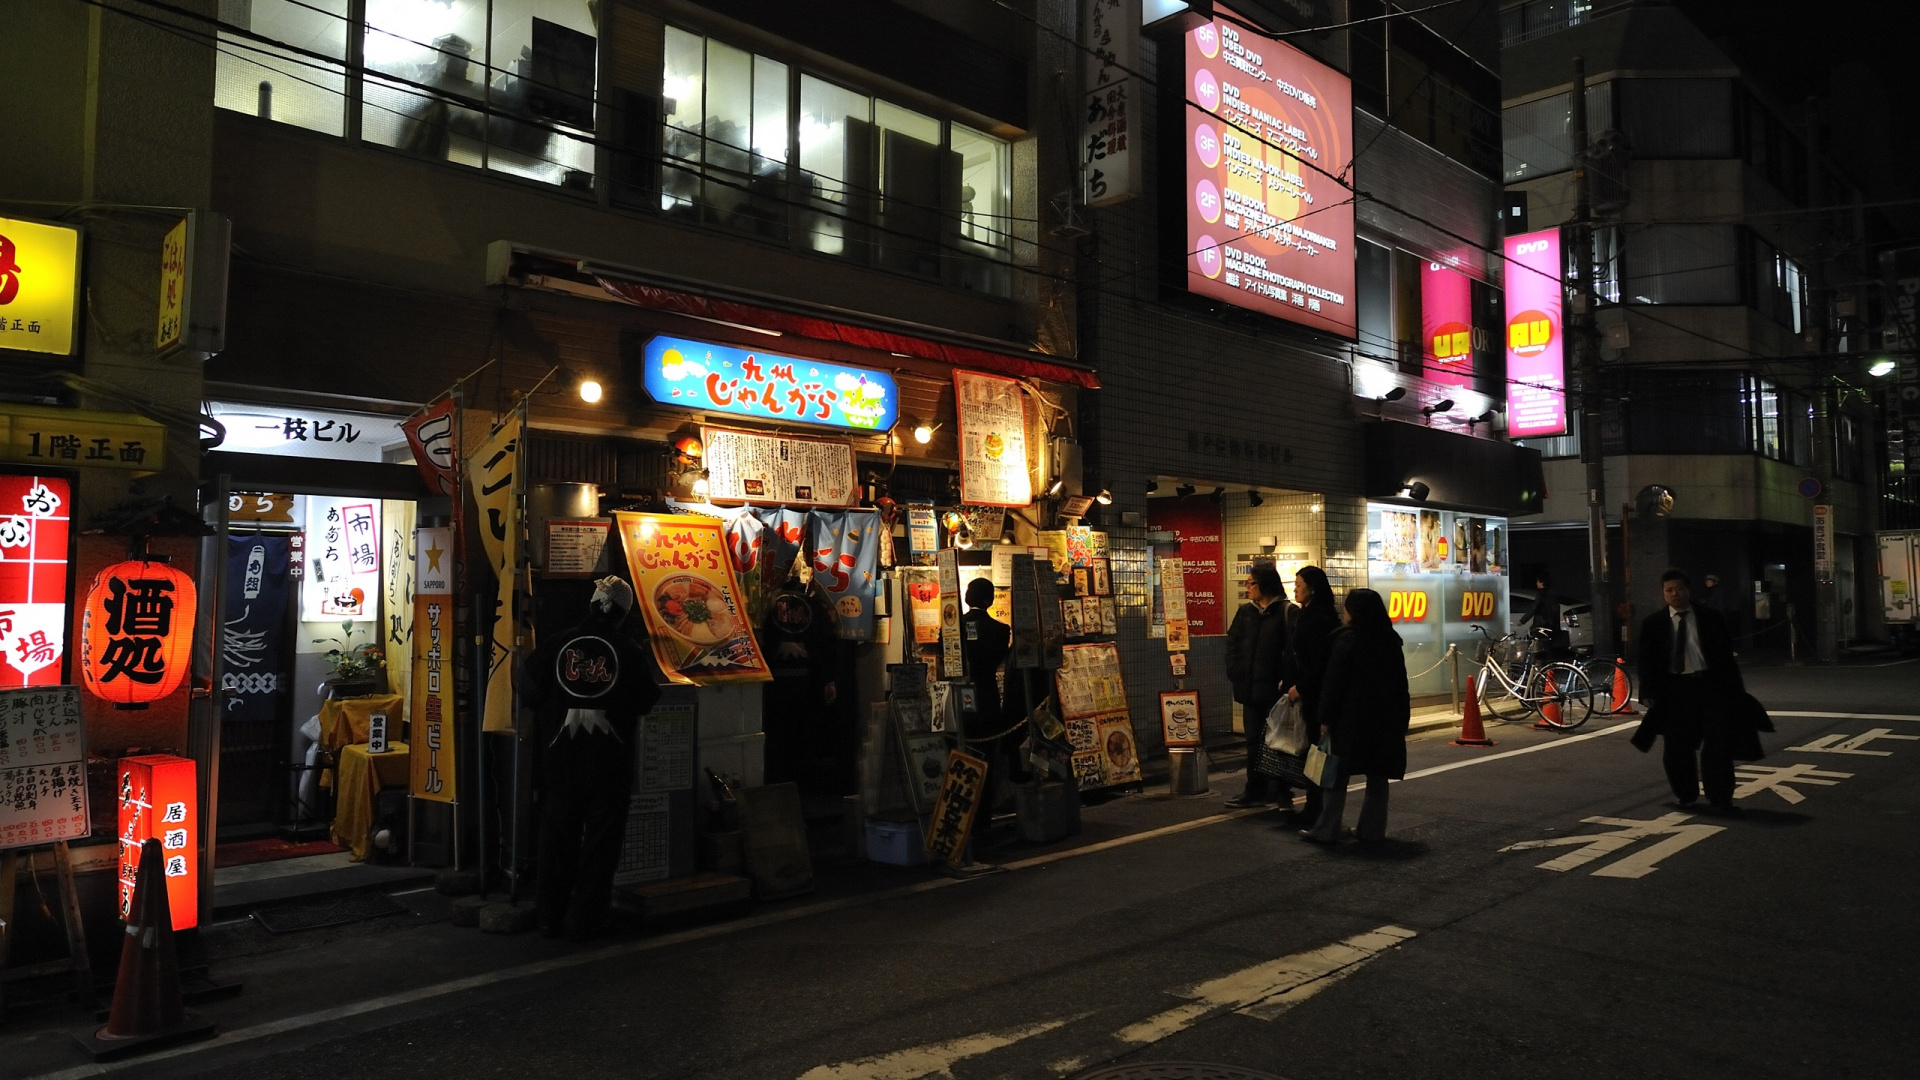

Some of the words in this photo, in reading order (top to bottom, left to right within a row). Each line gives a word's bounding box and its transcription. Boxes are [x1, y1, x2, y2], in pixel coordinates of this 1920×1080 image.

[1222, 25, 1239, 42] DVD
[1222, 36, 1245, 57] USED
[1245, 49, 1263, 66] DVD
[1199, 81, 1215, 98] 4F
[1223, 81, 1240, 99] DVD
[1223, 93, 1250, 115] INDIES
[1251, 108, 1283, 130] MANIAC
[1283, 122, 1307, 142] LABEL
[1087, 95, 1108, 198] あだち
[1200, 135, 1215, 152] 3F
[1223, 109, 1262, 134] インディーズ
[1266, 127, 1318, 160] マニアックレーベル
[1223, 133, 1241, 150] DVD
[1223, 145, 1252, 165] INDIES
[1252, 157, 1281, 177] MAJOR
[1281, 169, 1305, 188] LABEL
[1223, 161, 1263, 184] インディーズ
[1267, 178, 1313, 205] メジャーレーベル
[1200, 192, 1216, 208] 2F
[1223, 188, 1241, 204] DVD
[1243, 194, 1266, 211] BOOK
[1223, 202, 1262, 225] MAGAZINE
[1293, 223, 1337, 250] MAJORMAKER
[1202, 249, 1216, 264] 1F
[1225, 246, 1242, 261] DVD
[1243, 252, 1267, 269] BOOK
[1517, 240, 1549, 256] DVD
[1225, 258, 1263, 279] MAGAZINE
[1262, 269, 1306, 294] PHOTOGRAPH
[1305, 283, 1344, 305] COLLECTION
[741, 355, 797, 384] 九州
[706, 371, 838, 421] じゃんがら
[254, 417, 361, 444] 一枝ビル
[27, 432, 147, 465] 1階正面
[325, 507, 341, 561] あだち
[347, 513, 375, 567] 市場
[653, 530, 699, 549] 九州
[290, 535, 304, 578] 営業中
[636, 549, 720, 570] じゃんがら
[423, 580, 445, 590] SAPPORO
[1388, 589, 1428, 622] DVD
[1461, 590, 1495, 621] DVD
[100, 576, 175, 684] 酒処
[12, 697, 29, 725] 豚汁
[46, 694, 62, 727] おでん
[425, 603, 443, 793] サッポロ生ビール
[30, 695, 47, 737] 肉じゃが
[371, 717, 384, 751] 営業中
[14, 769, 26, 812] 本日の焼魚
[25, 768, 38, 810] 本日の刺身
[39, 768, 49, 797] キムチ
[67, 764, 84, 812] 厚焼き玉子
[166, 804, 185, 875] 居酒屋
